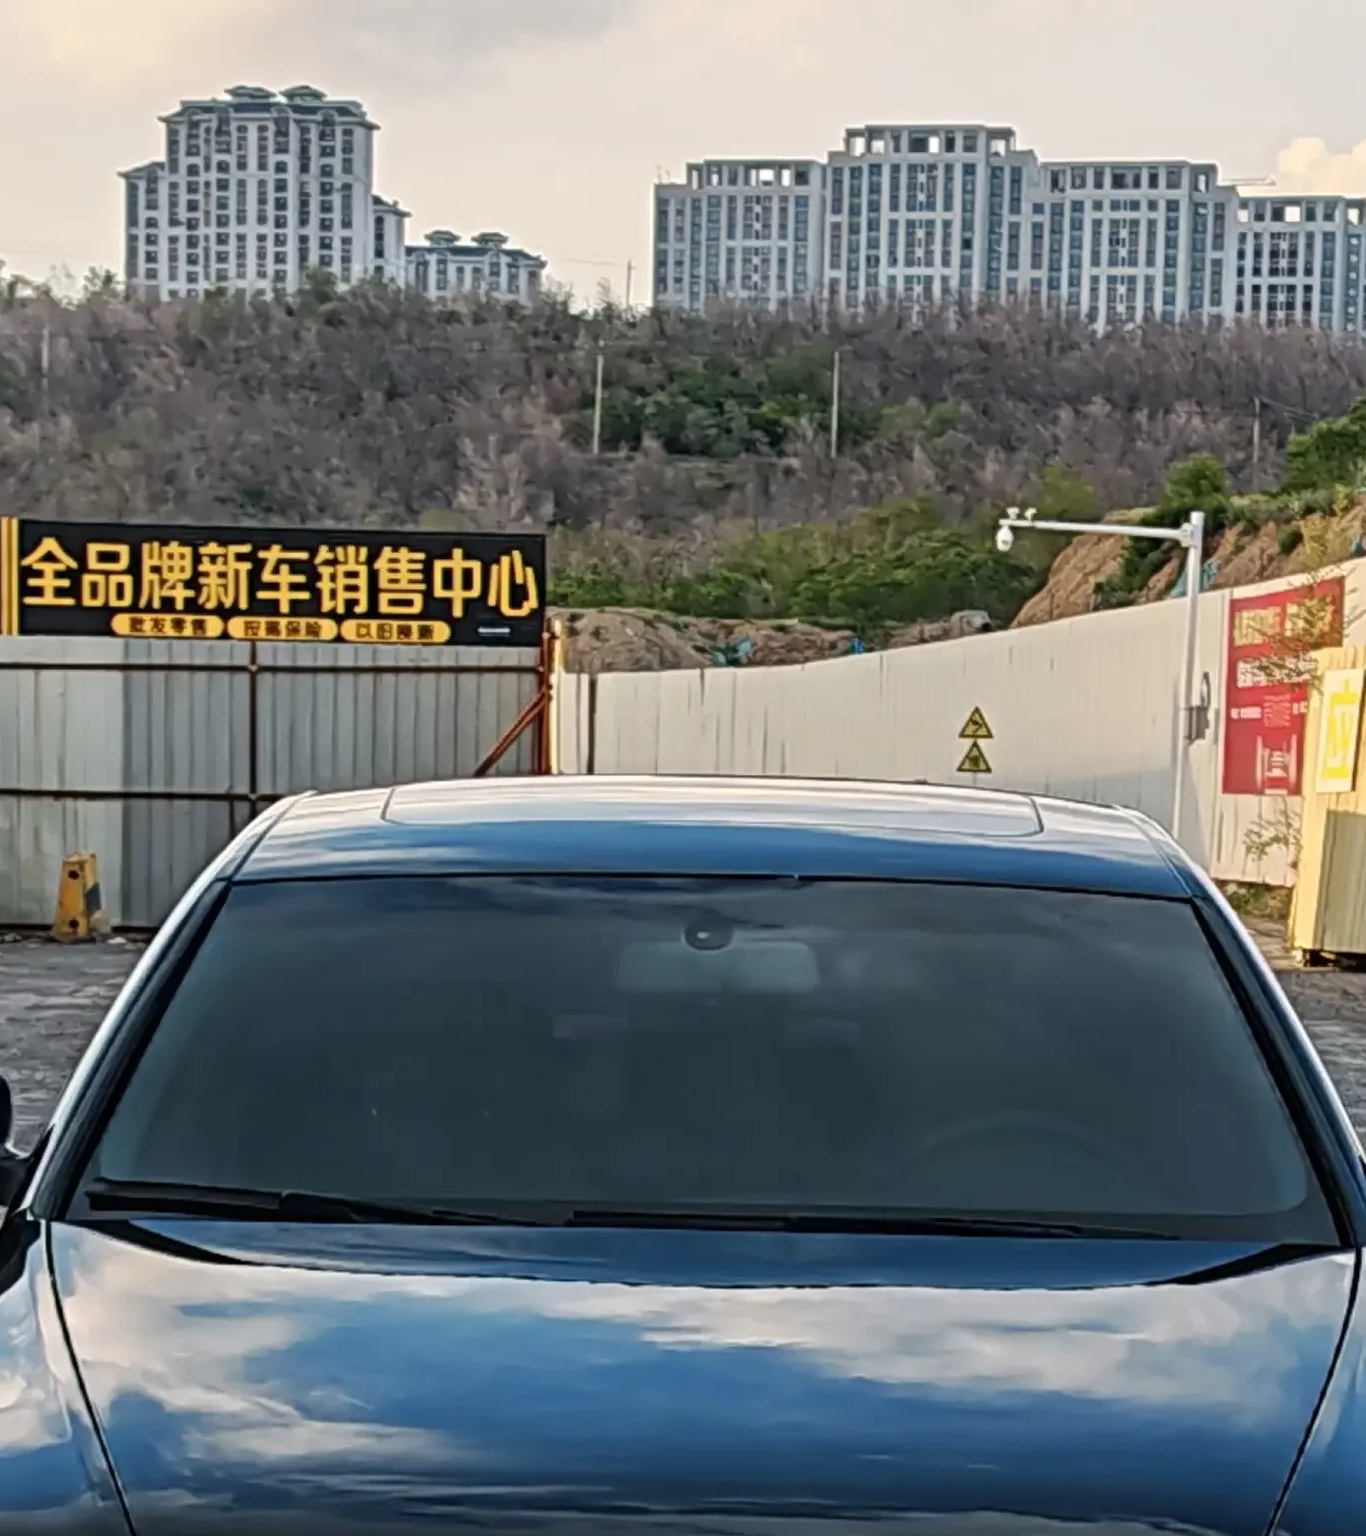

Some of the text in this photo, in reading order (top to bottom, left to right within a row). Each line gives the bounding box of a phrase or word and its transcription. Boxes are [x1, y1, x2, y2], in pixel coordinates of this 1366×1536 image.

[20, 536, 540, 618] 全品牌新车销售中心
